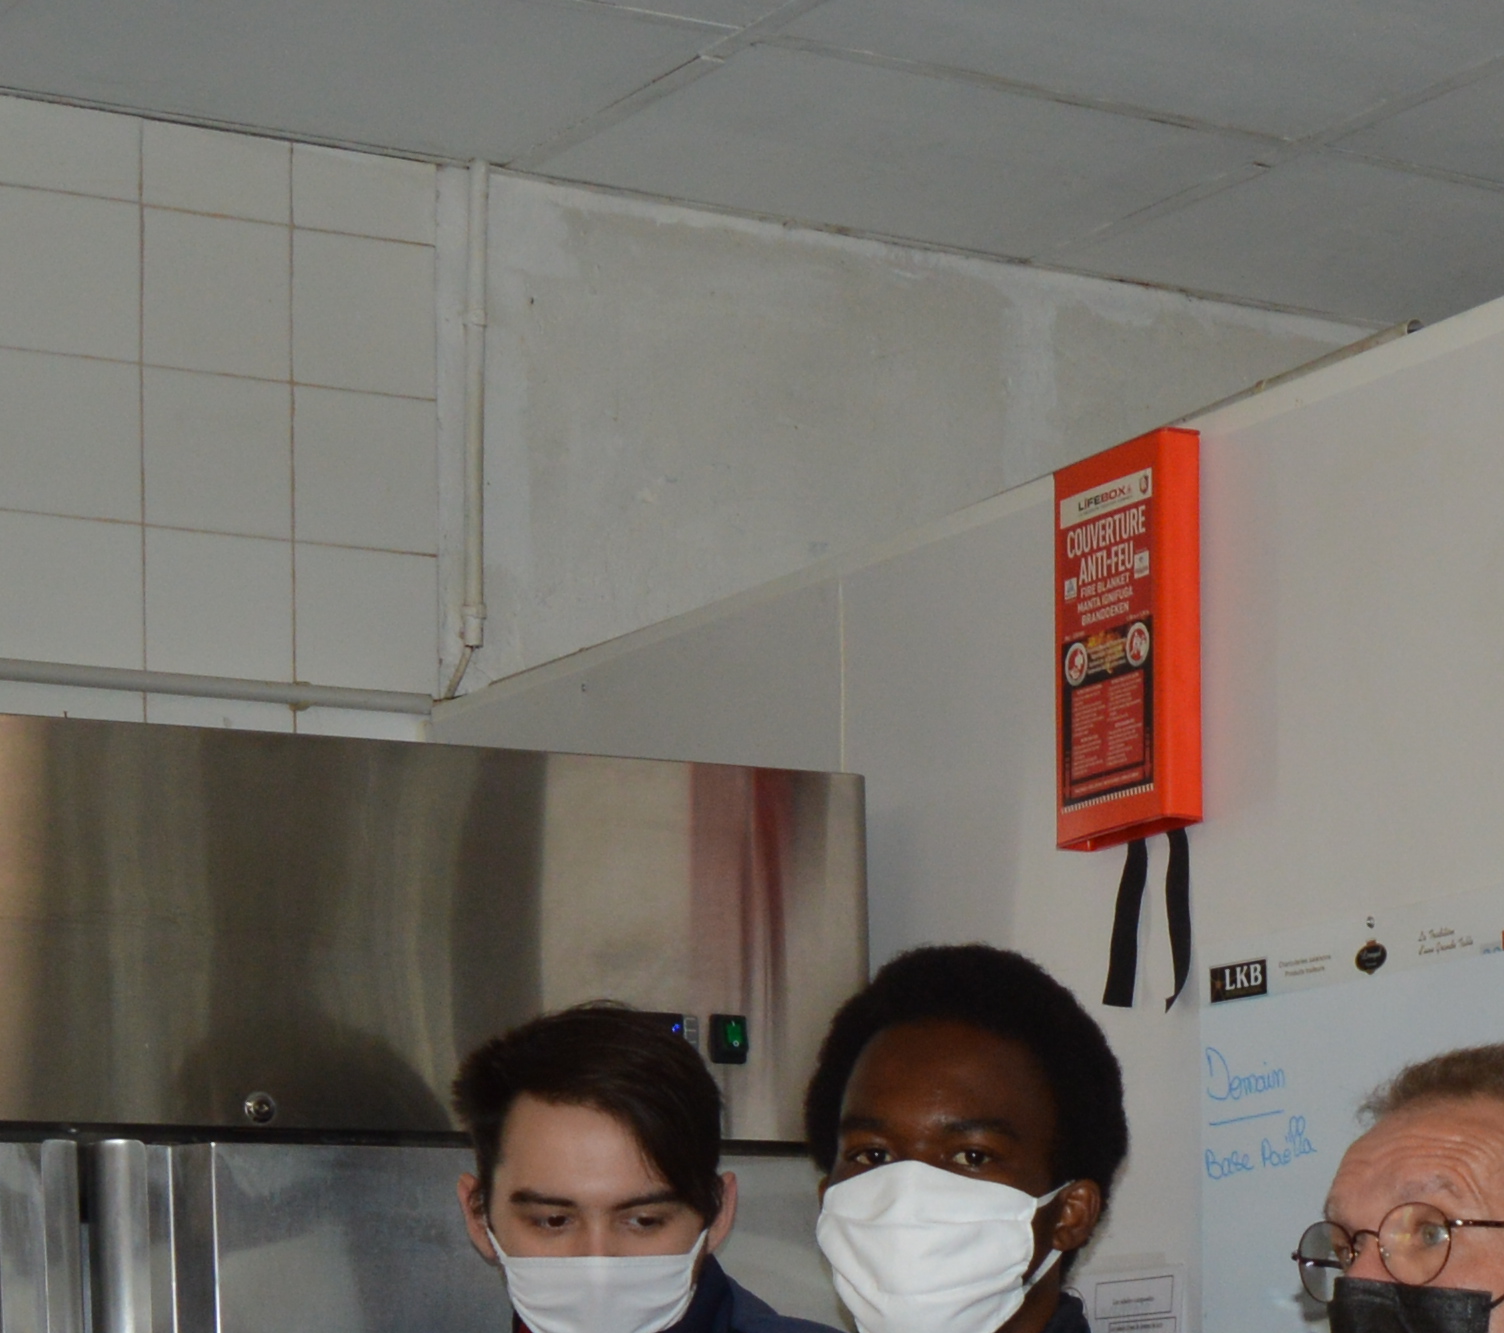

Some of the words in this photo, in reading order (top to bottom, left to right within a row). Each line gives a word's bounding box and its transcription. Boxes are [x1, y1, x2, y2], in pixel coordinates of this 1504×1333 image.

[1067, 505, 1146, 559] COUVERTURE
[1079, 540, 1134, 586] ANTI-FEU
[1080, 584, 1096, 599] FIRE
[1097, 572, 1130, 593] BLANKET
[1077, 598, 1101, 613] MANTA
[1224, 962, 1263, 991] LKB
[1205, 1046, 1285, 1100] Demain
